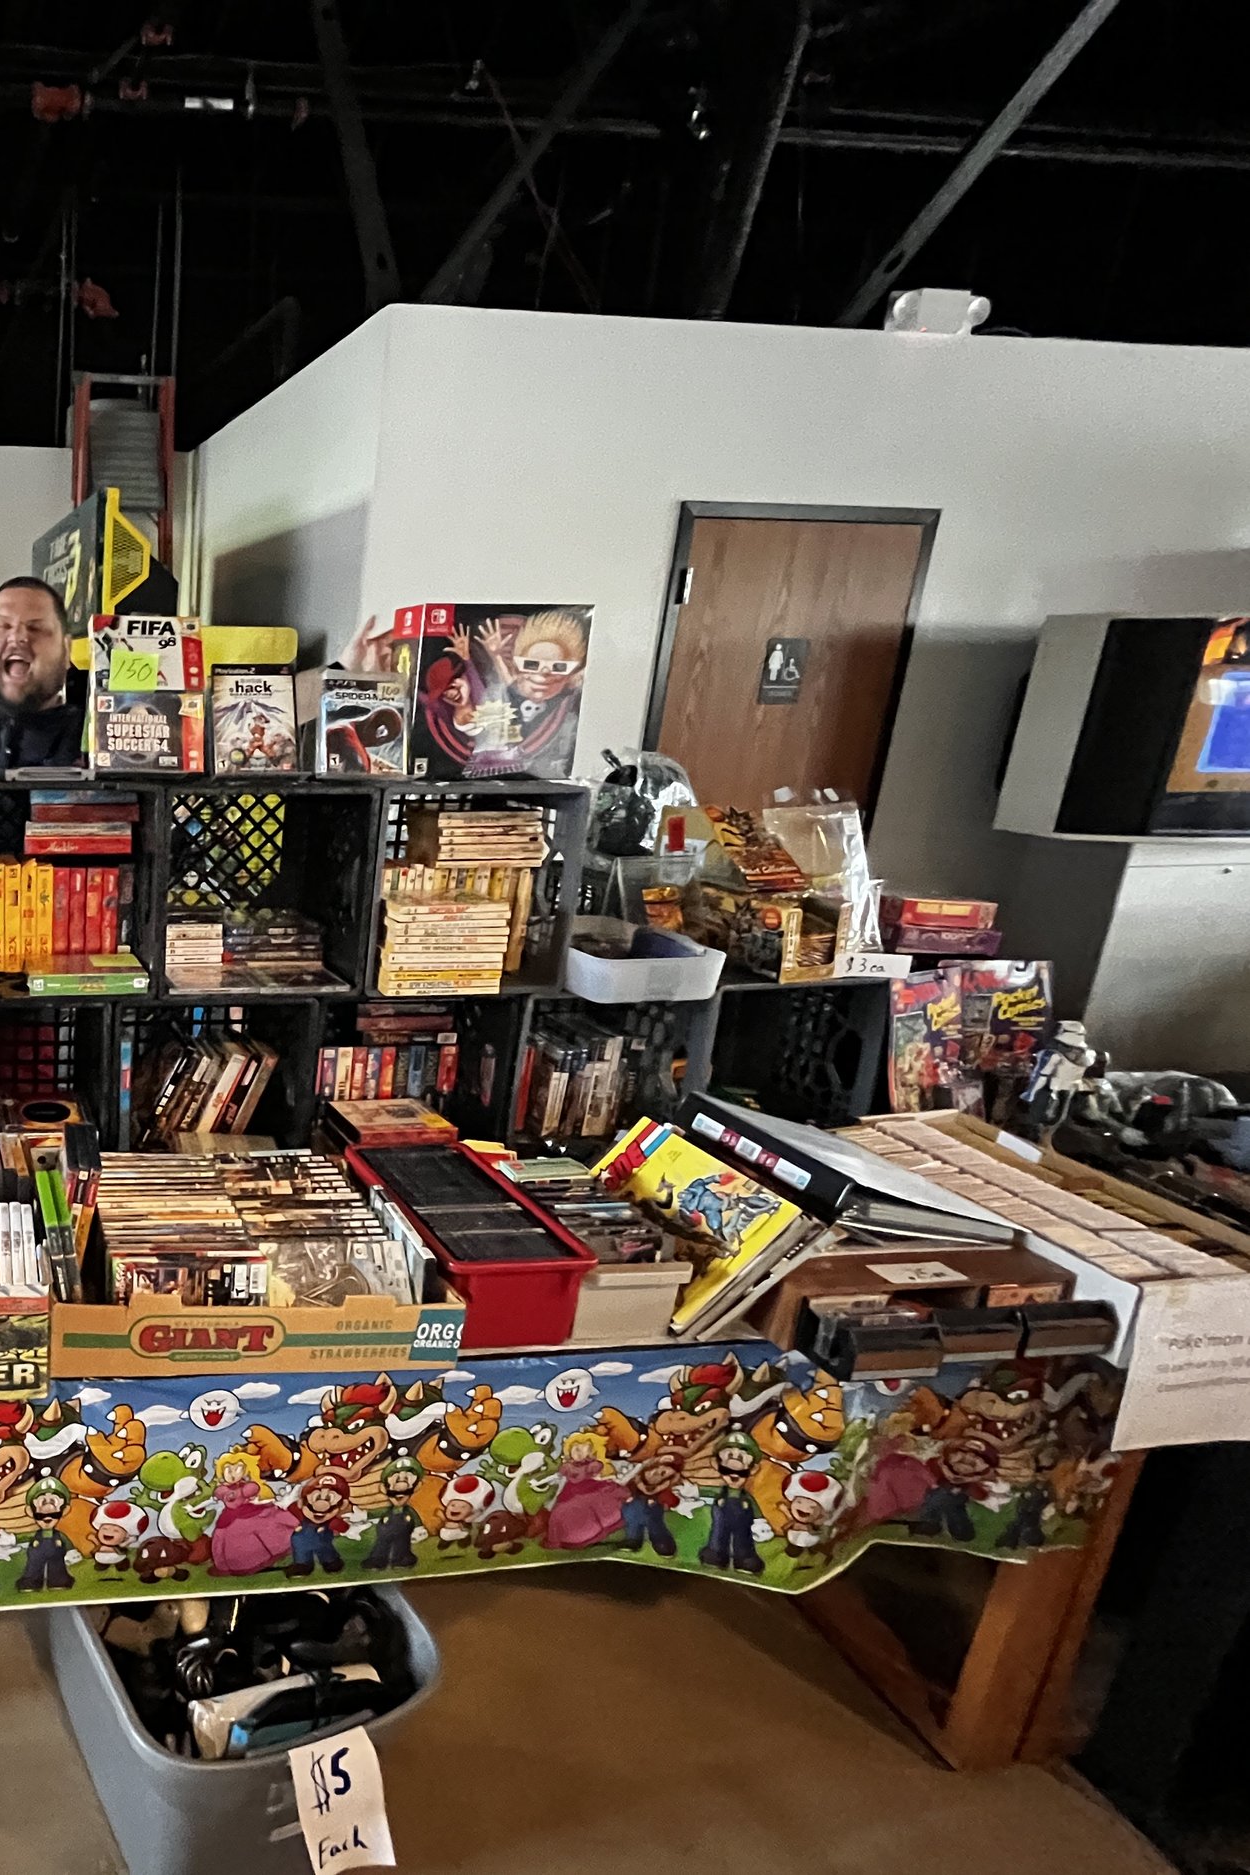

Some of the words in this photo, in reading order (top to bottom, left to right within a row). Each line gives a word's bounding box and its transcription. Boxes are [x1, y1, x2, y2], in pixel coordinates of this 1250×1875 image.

[127, 620, 176, 636] FIFA
[158, 637, 177, 649] 98
[111, 657, 152, 682] 150
[109, 714, 168, 724] INTERNATIONAL
[106, 724, 171, 738] SUPERSTAR
[107, 737, 152, 752] SOCCER
[336, 1319, 394, 1331] ORGANIC
[139, 1325, 275, 1353] GIANT
[413, 1339, 453, 1349] ORGANIC
[309, 1347, 408, 1360] STRAWBERRIES
[309, 1747, 352, 1816] $5
